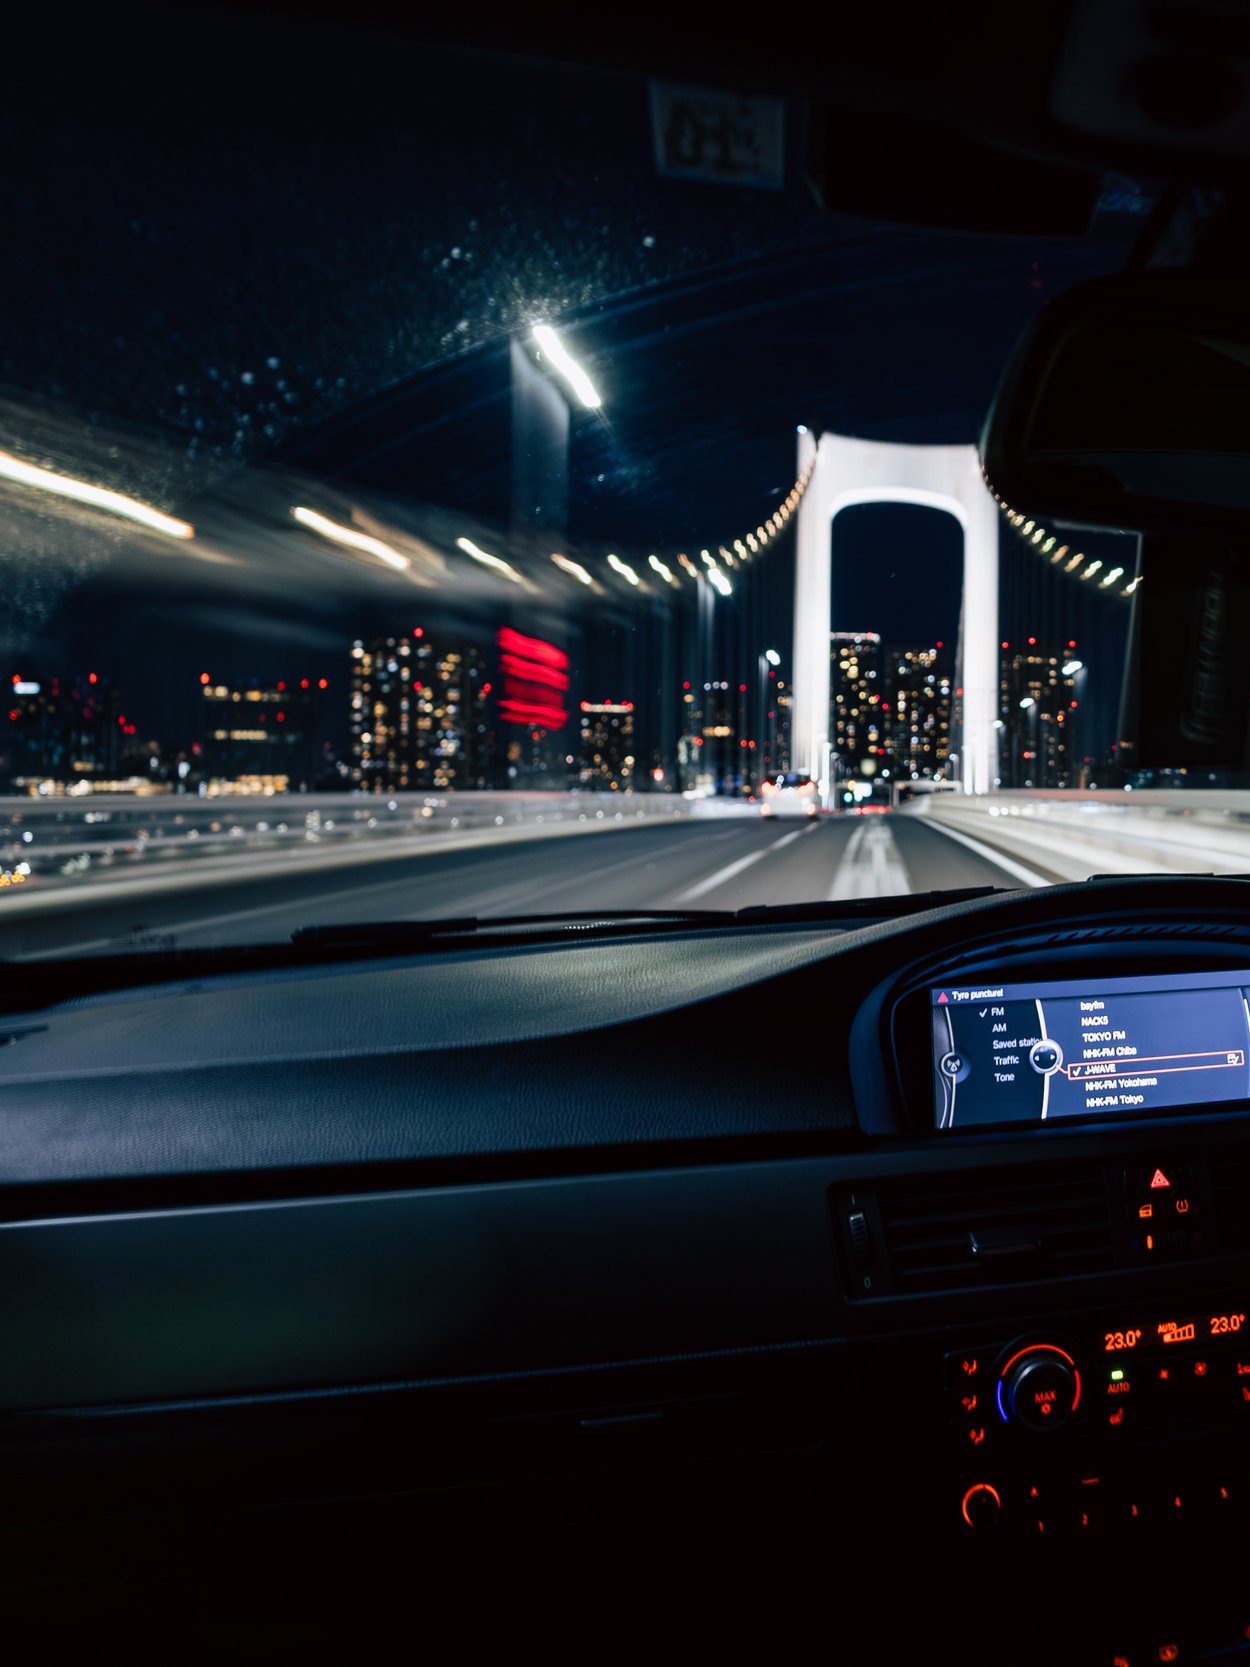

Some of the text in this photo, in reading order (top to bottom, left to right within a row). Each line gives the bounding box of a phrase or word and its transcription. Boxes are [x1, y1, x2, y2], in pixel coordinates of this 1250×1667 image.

[952, 991, 969, 1001] Tyre
[991, 1007, 1005, 1016] FM
[1081, 1016, 1109, 1026] NACK5
[992, 1023, 1007, 1032] AM
[1082, 1031, 1126, 1042] TOKYO FM
[993, 1039, 1017, 1050] Saved
[1083, 1046, 1137, 1058] NHK-FM Chiba
[994, 1055, 1020, 1066] Traffic
[1085, 1064, 1116, 1075] J-WAVE
[994, 1072, 1015, 1082] Tone
[1085, 1077, 1157, 1091] NHK-FM Yokohama
[1086, 1094, 1144, 1107] NHK-FM Tokyo
[1157, 1322, 1177, 1334] AUTO
[1108, 1381, 1130, 1394] AUTO
[1035, 1390, 1057, 1404] MAX
